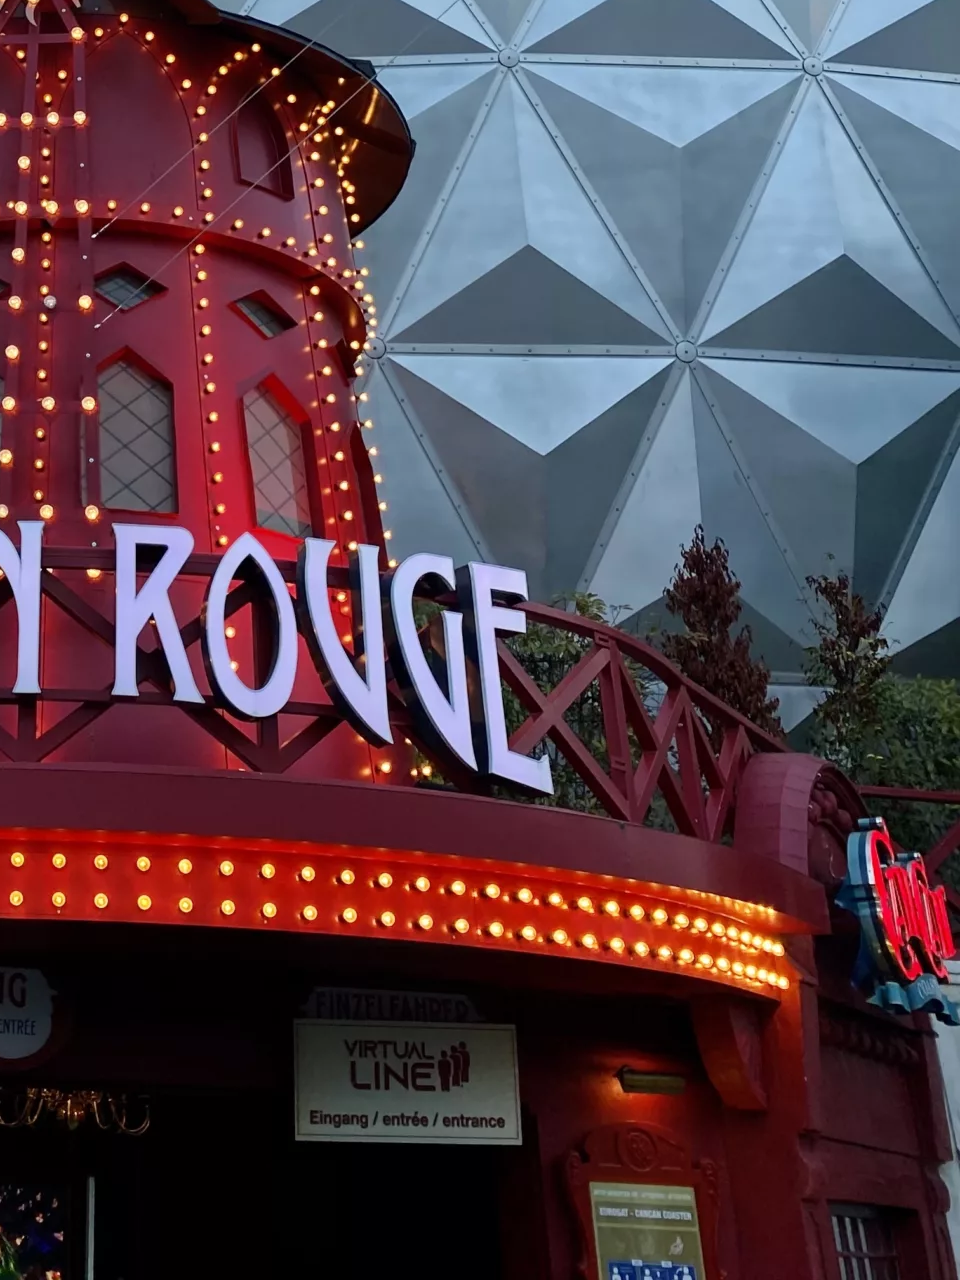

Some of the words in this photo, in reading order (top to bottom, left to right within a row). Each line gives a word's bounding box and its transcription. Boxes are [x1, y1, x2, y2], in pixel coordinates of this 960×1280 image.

[113, 523, 555, 796] ROUGE
[343, 1039, 435, 1060] VIRTUAL
[350, 1061, 436, 1092] LINE
[309, 1110, 369, 1129] Eingang
[383, 1111, 429, 1128] entrée
[442, 1113, 506, 1129] entrance
